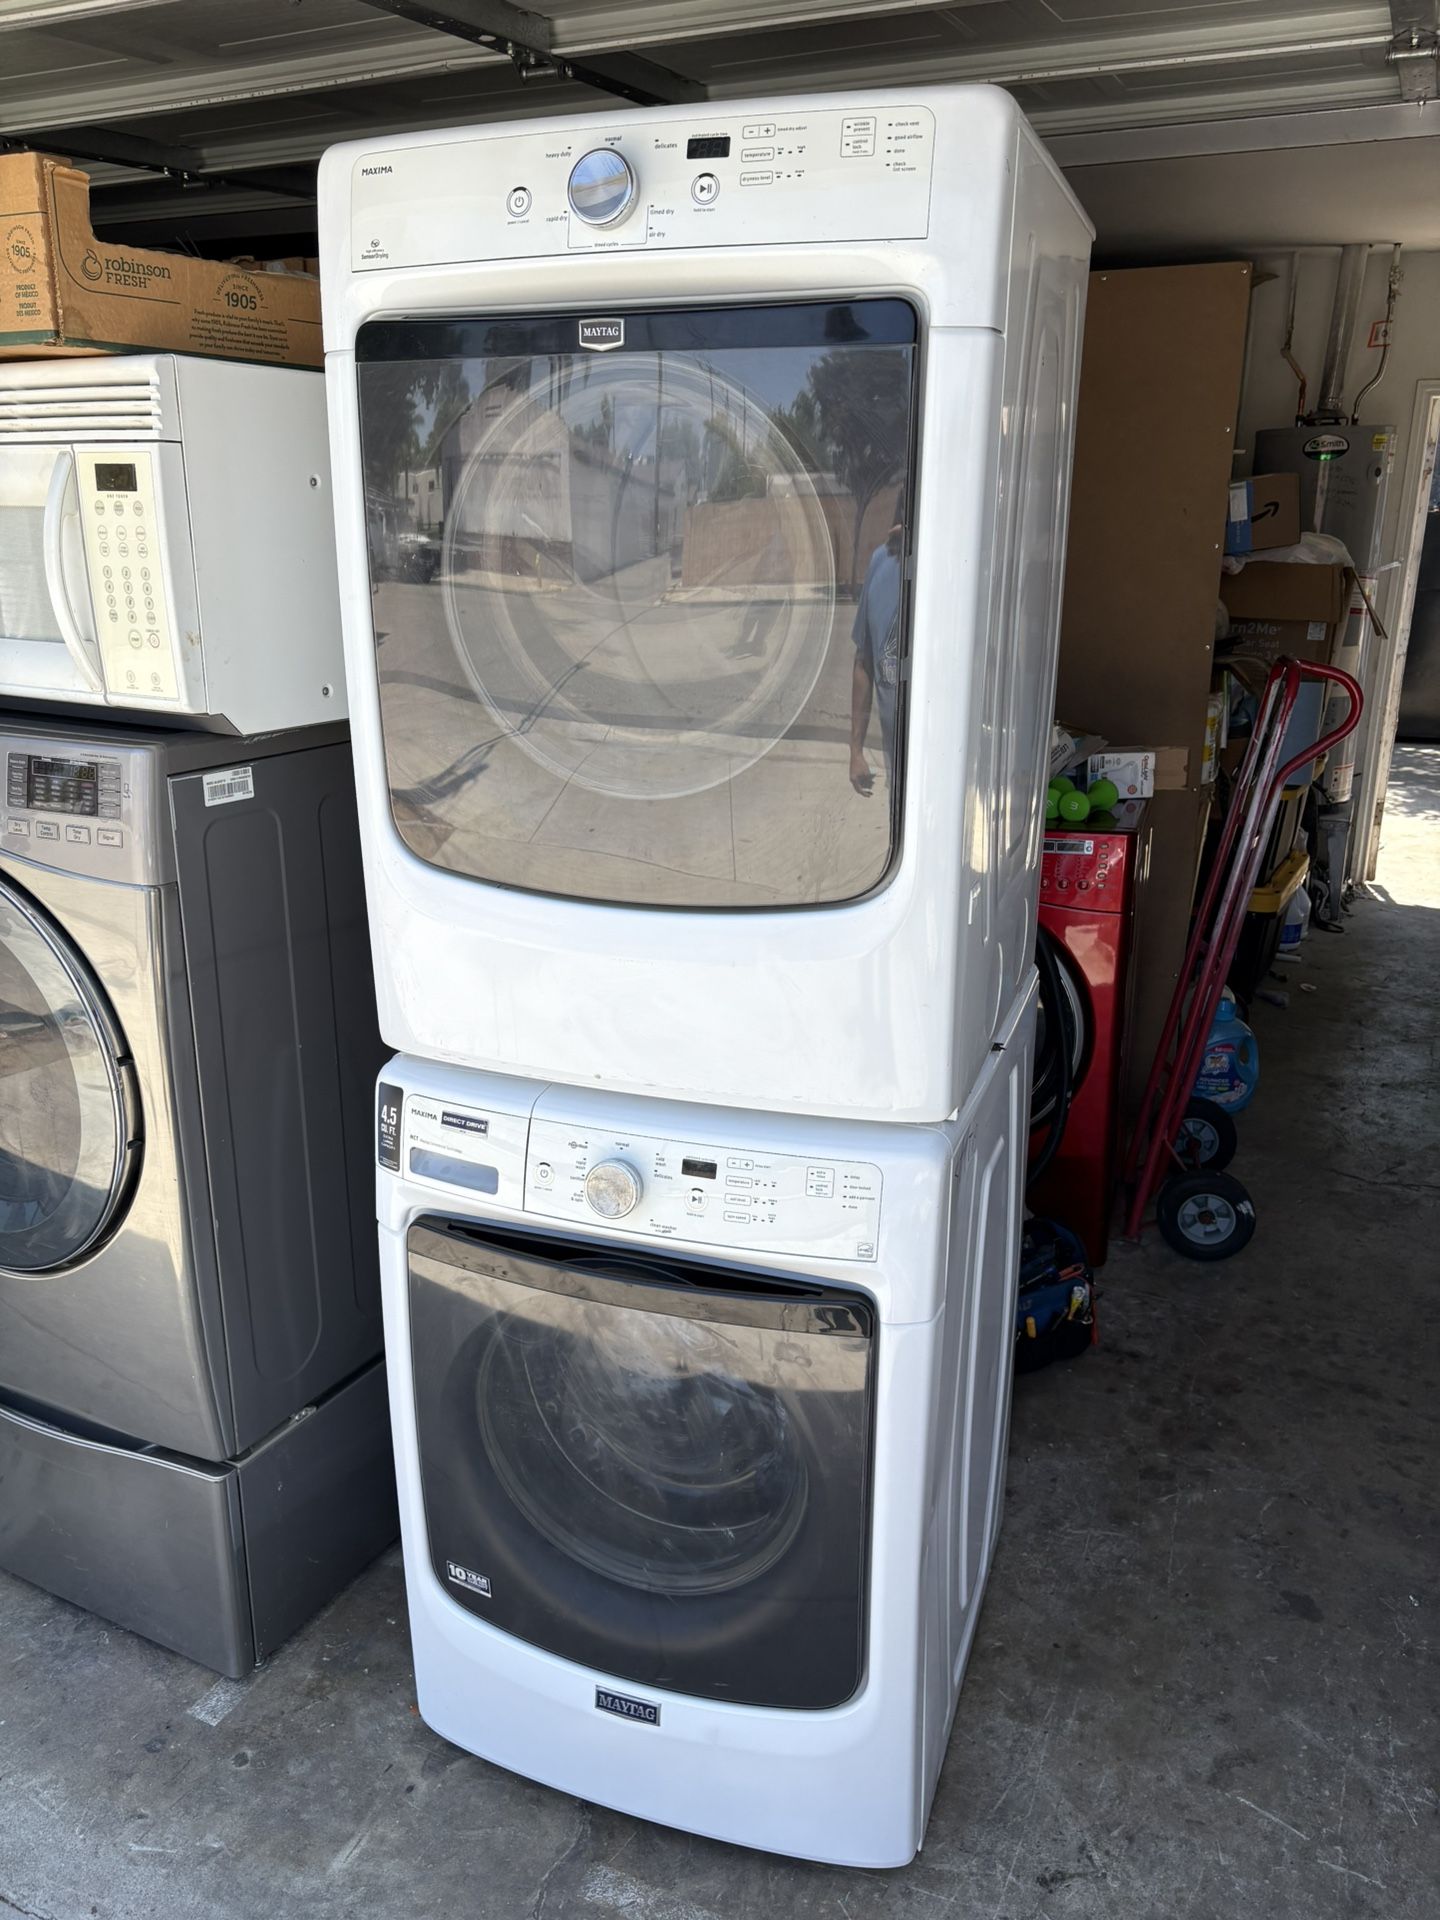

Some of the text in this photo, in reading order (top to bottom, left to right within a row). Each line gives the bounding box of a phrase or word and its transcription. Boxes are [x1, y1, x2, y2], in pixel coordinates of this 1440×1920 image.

[361, 166, 393, 176] MAXIMA
[12, 244, 31, 257] 1905
[104, 257, 171, 279] robinson
[225, 291, 257, 310] 1905
[583, 327, 619, 336] MAYTAG
[381, 1104, 397, 1126] 4.5
[411, 1108, 438, 1120] MAXIMA
[443, 1116, 486, 1130] DIRECT DRIVE
[449, 1564, 466, 1580] 10
[599, 1695, 655, 1720] MAYTAG
